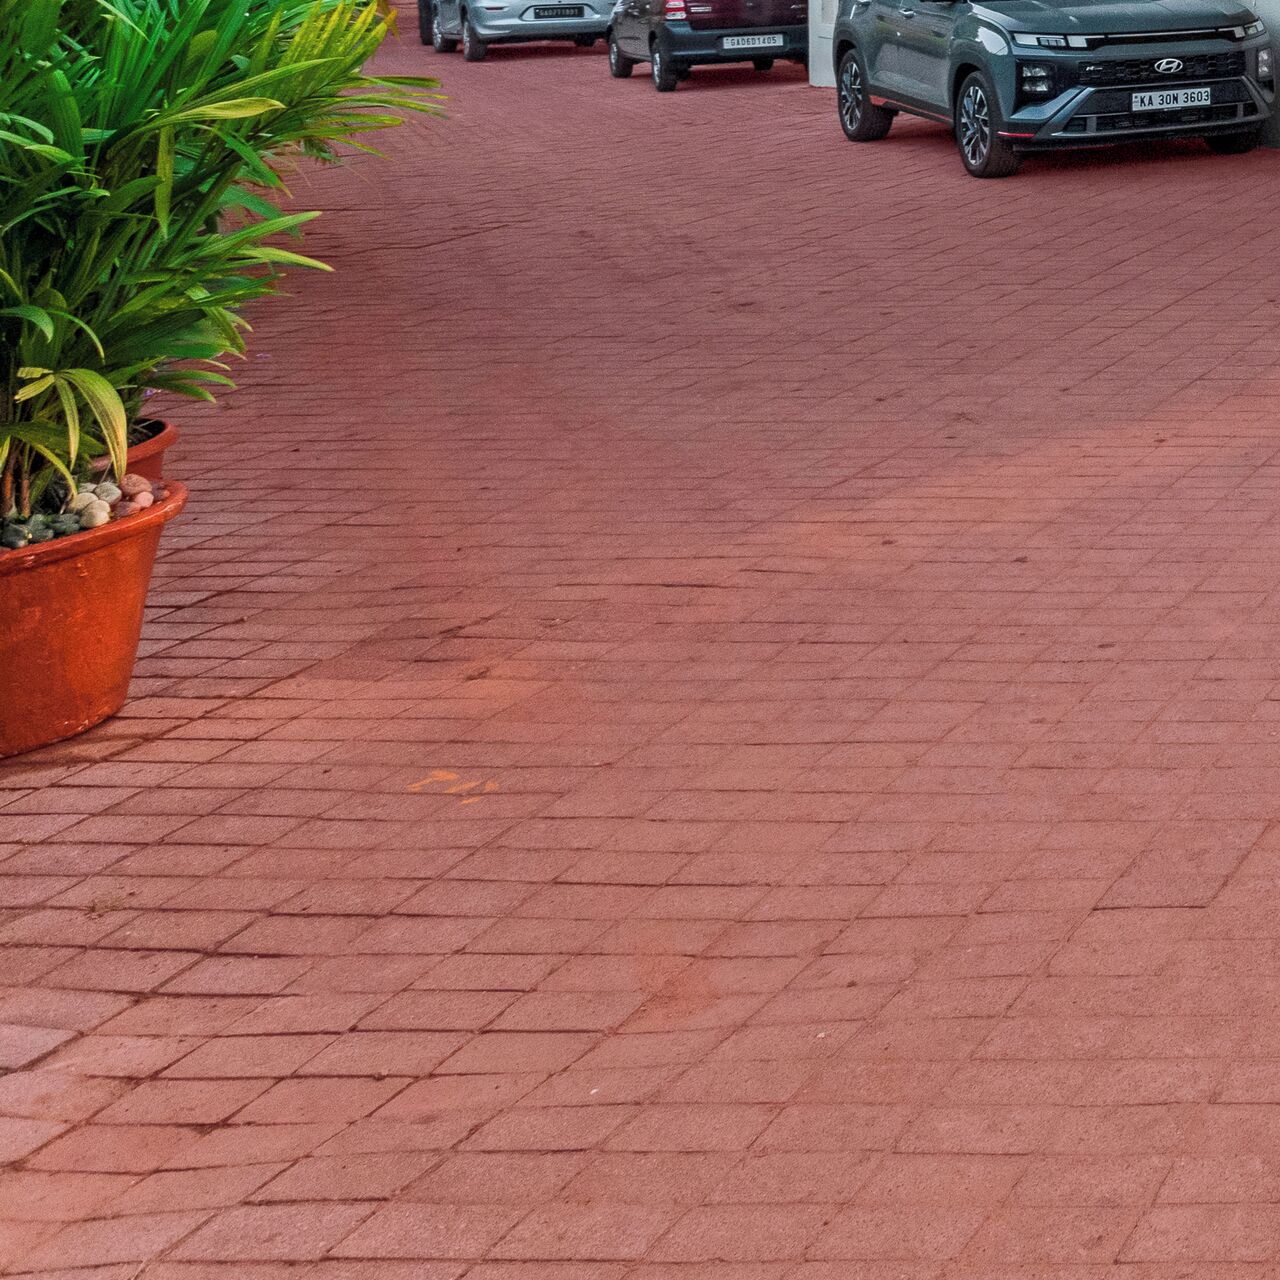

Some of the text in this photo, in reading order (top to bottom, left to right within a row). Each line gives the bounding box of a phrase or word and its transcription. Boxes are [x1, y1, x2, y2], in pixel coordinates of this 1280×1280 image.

[1140, 90, 1210, 107] KA 30N 3603
